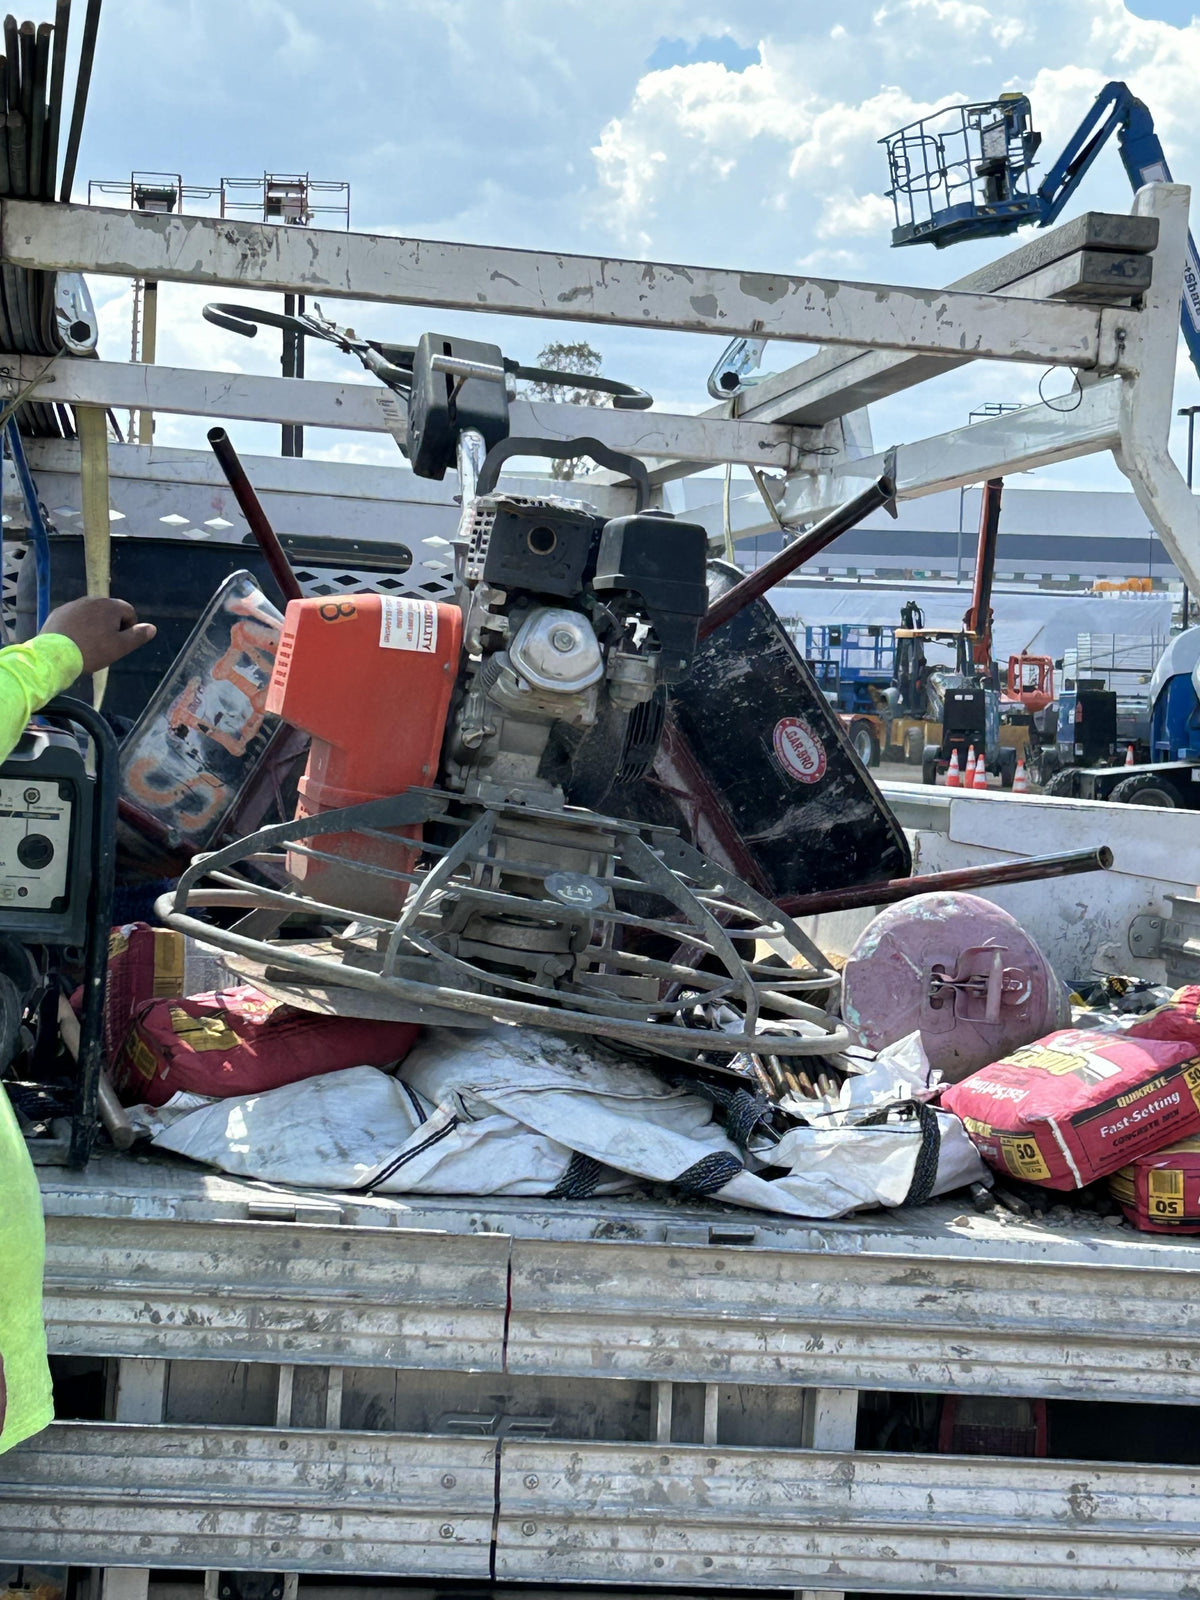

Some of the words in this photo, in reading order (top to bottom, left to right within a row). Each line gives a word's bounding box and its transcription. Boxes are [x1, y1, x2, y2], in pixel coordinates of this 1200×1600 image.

[1116, 1076, 1169, 1108] QUIKRETE
[1100, 1091, 1181, 1138] Fast-Setting
[1016, 1143, 1036, 1160] 50
[1155, 1200, 1178, 1214] 50
